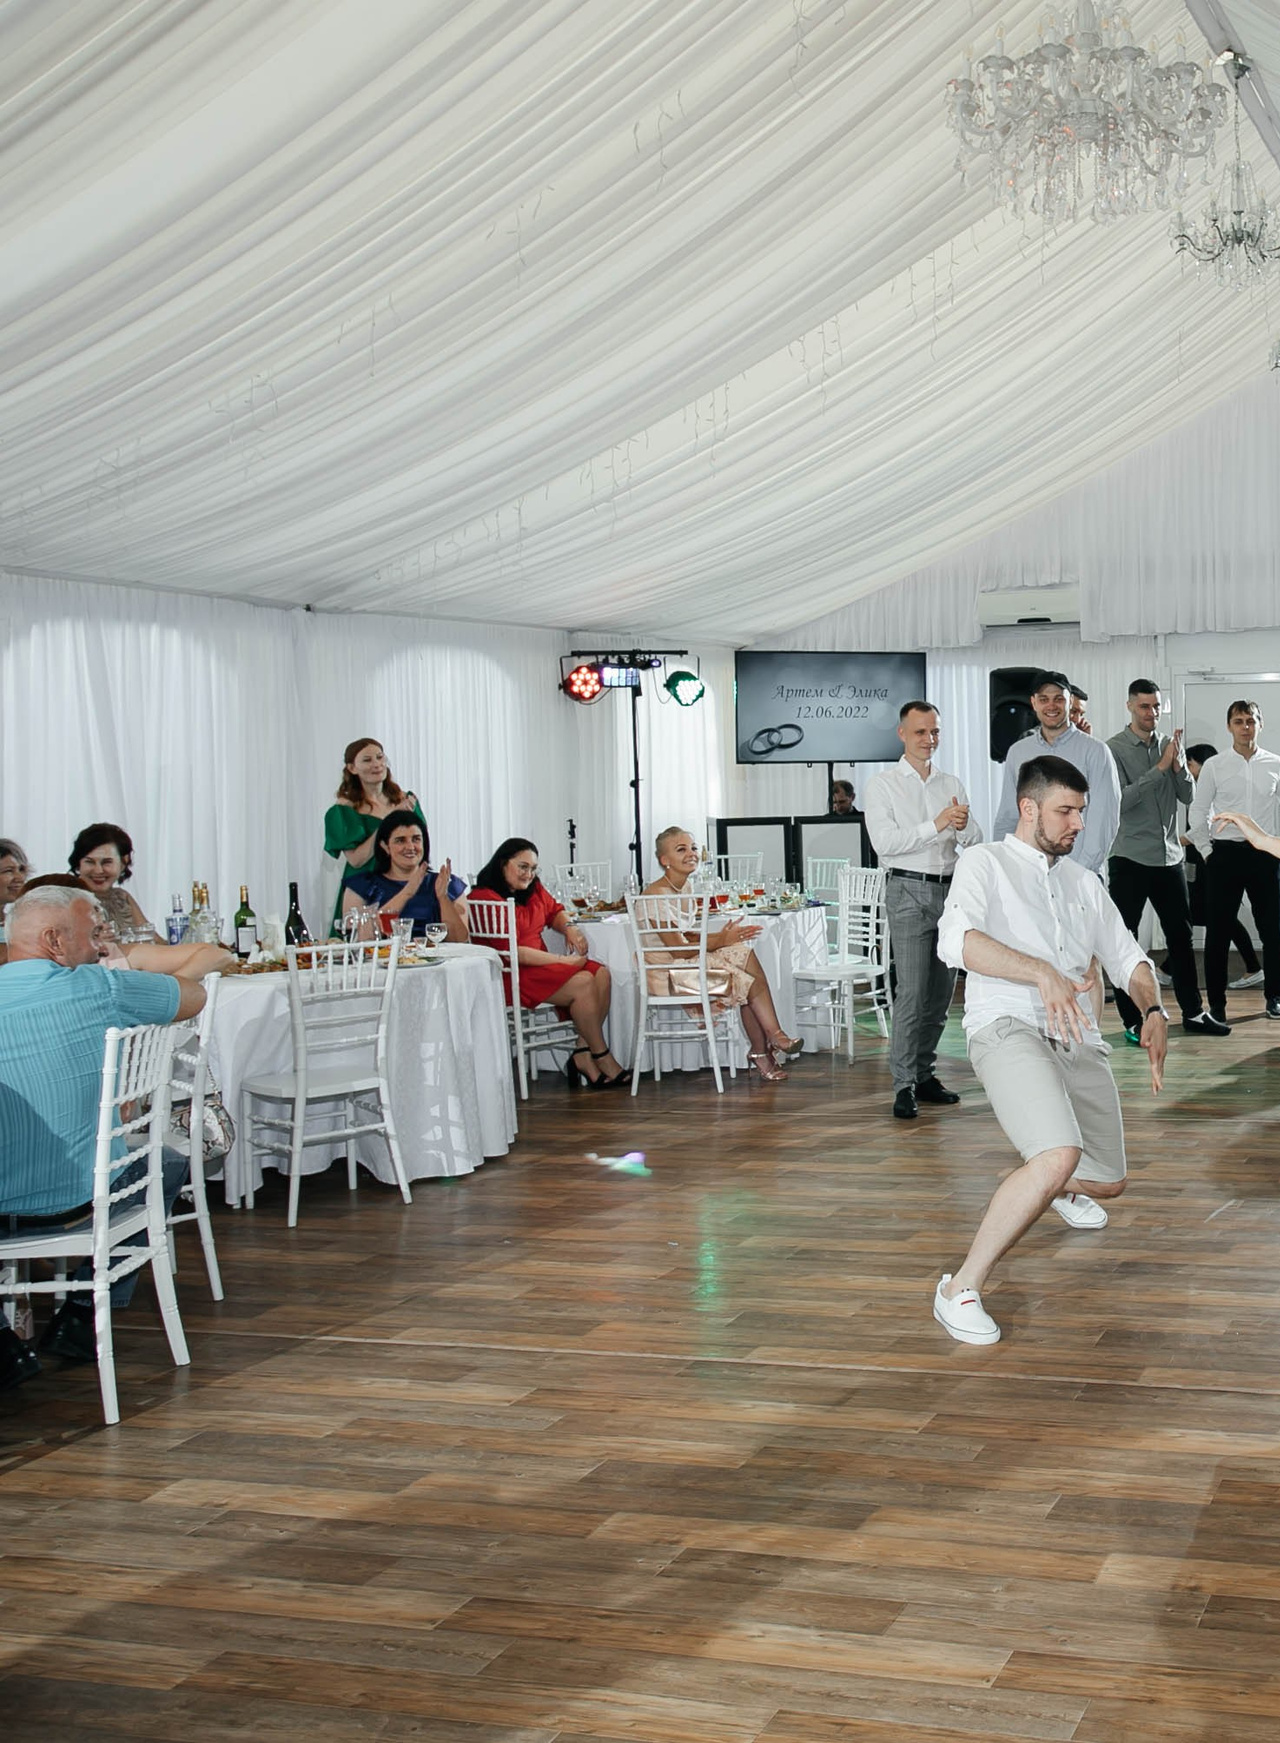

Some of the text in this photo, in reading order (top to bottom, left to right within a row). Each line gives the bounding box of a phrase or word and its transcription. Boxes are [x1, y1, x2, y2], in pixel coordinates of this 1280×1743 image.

[771, 683, 889, 702] Артем & Элика
[795, 705, 869, 719] 12.06.2022
